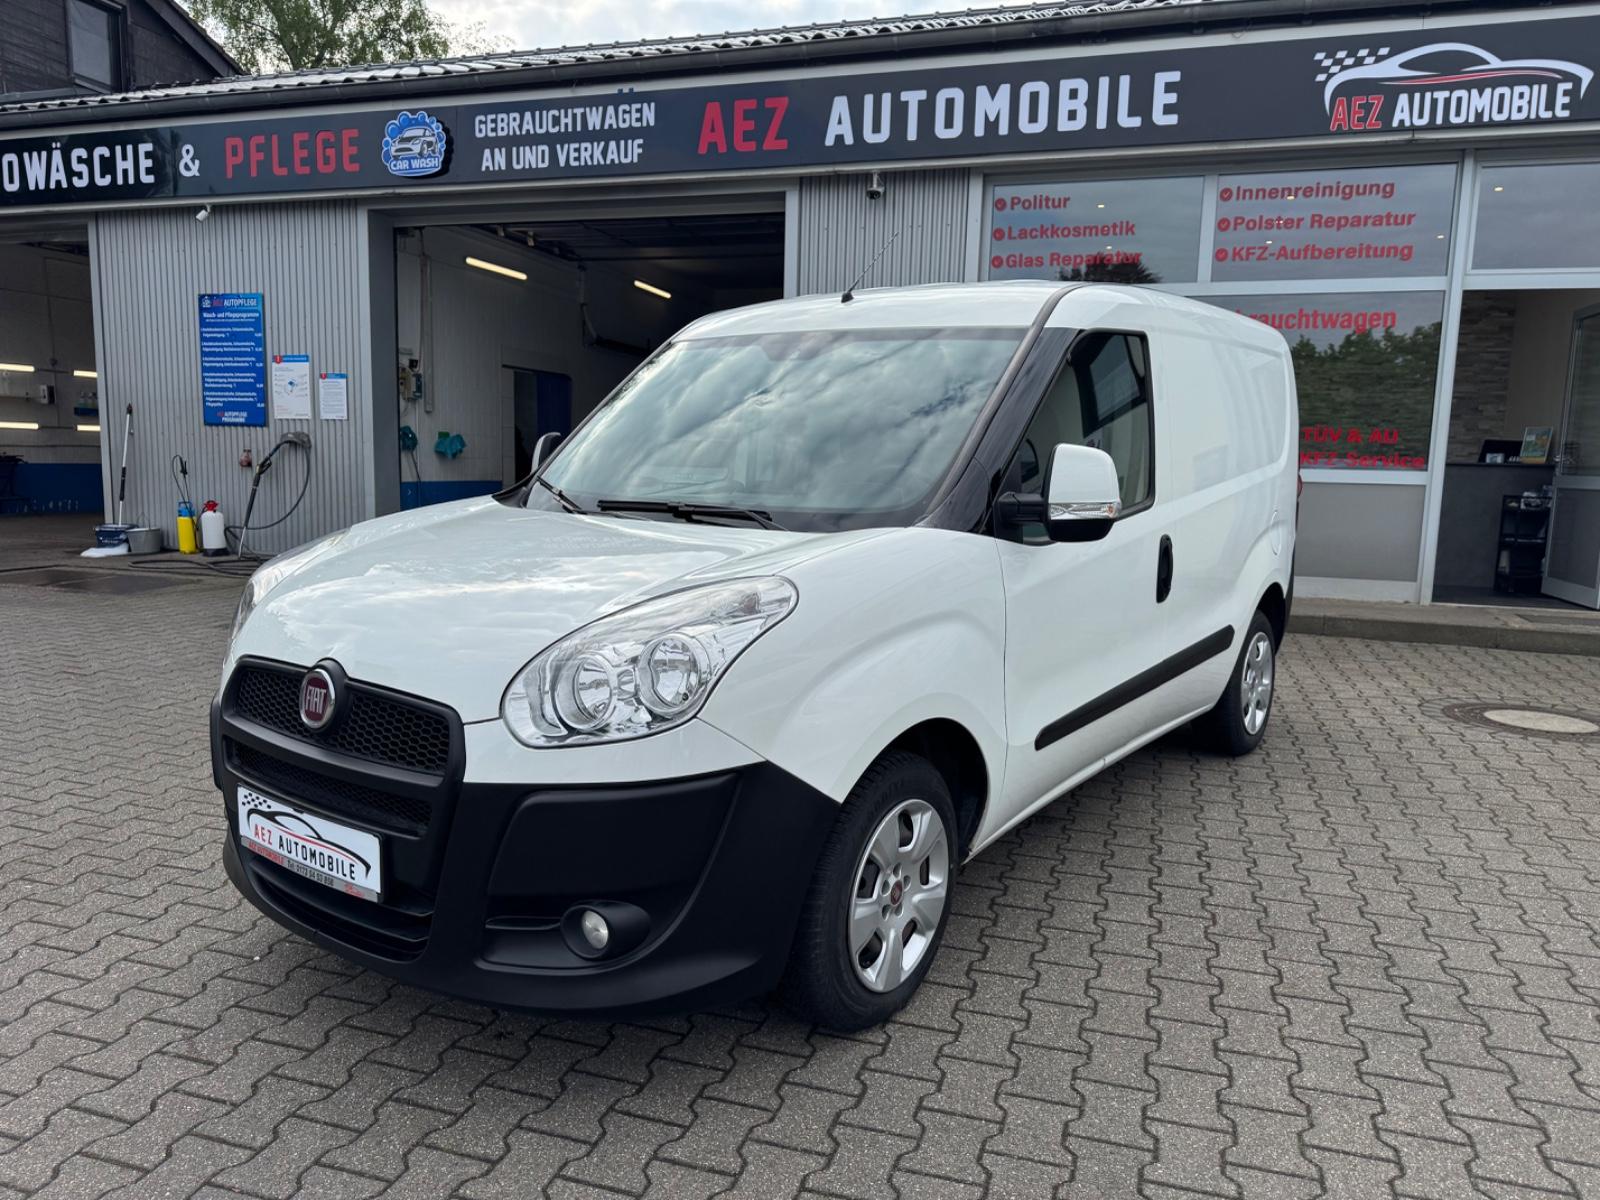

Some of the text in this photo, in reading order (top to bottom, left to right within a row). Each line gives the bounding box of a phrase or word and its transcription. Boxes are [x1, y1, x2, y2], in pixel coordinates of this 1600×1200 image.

[698, 70, 1182, 155] AEZ AUTOMOBILE
[1330, 82, 1573, 131] AEZ AUTOMOBILE
[474, 102, 656, 138] GEBRAUCHTWAGEN
[178, 144, 201, 177] &
[224, 128, 361, 179] PFLEGE
[390, 157, 439, 170] CAR WASH
[481, 138, 644, 172] AN UND VERKAUF
[1235, 181, 1395, 202] Innenreinigung
[1010, 194, 1071, 212] Politur
[1007, 221, 1136, 241] Lackkosmetik
[1232, 211, 1416, 232] Polster Reparatur
[1005, 249, 1142, 271] Glas Reparatur
[1231, 242, 1414, 263] KFZ-Aufbereitung
[224, 298, 257, 306] AUTOPFLEGE
[1301, 424, 1399, 444] TÜV & AU
[305, 685, 327, 714] FIAT
[254, 823, 357, 881] AEZ AUTOMOBILE
